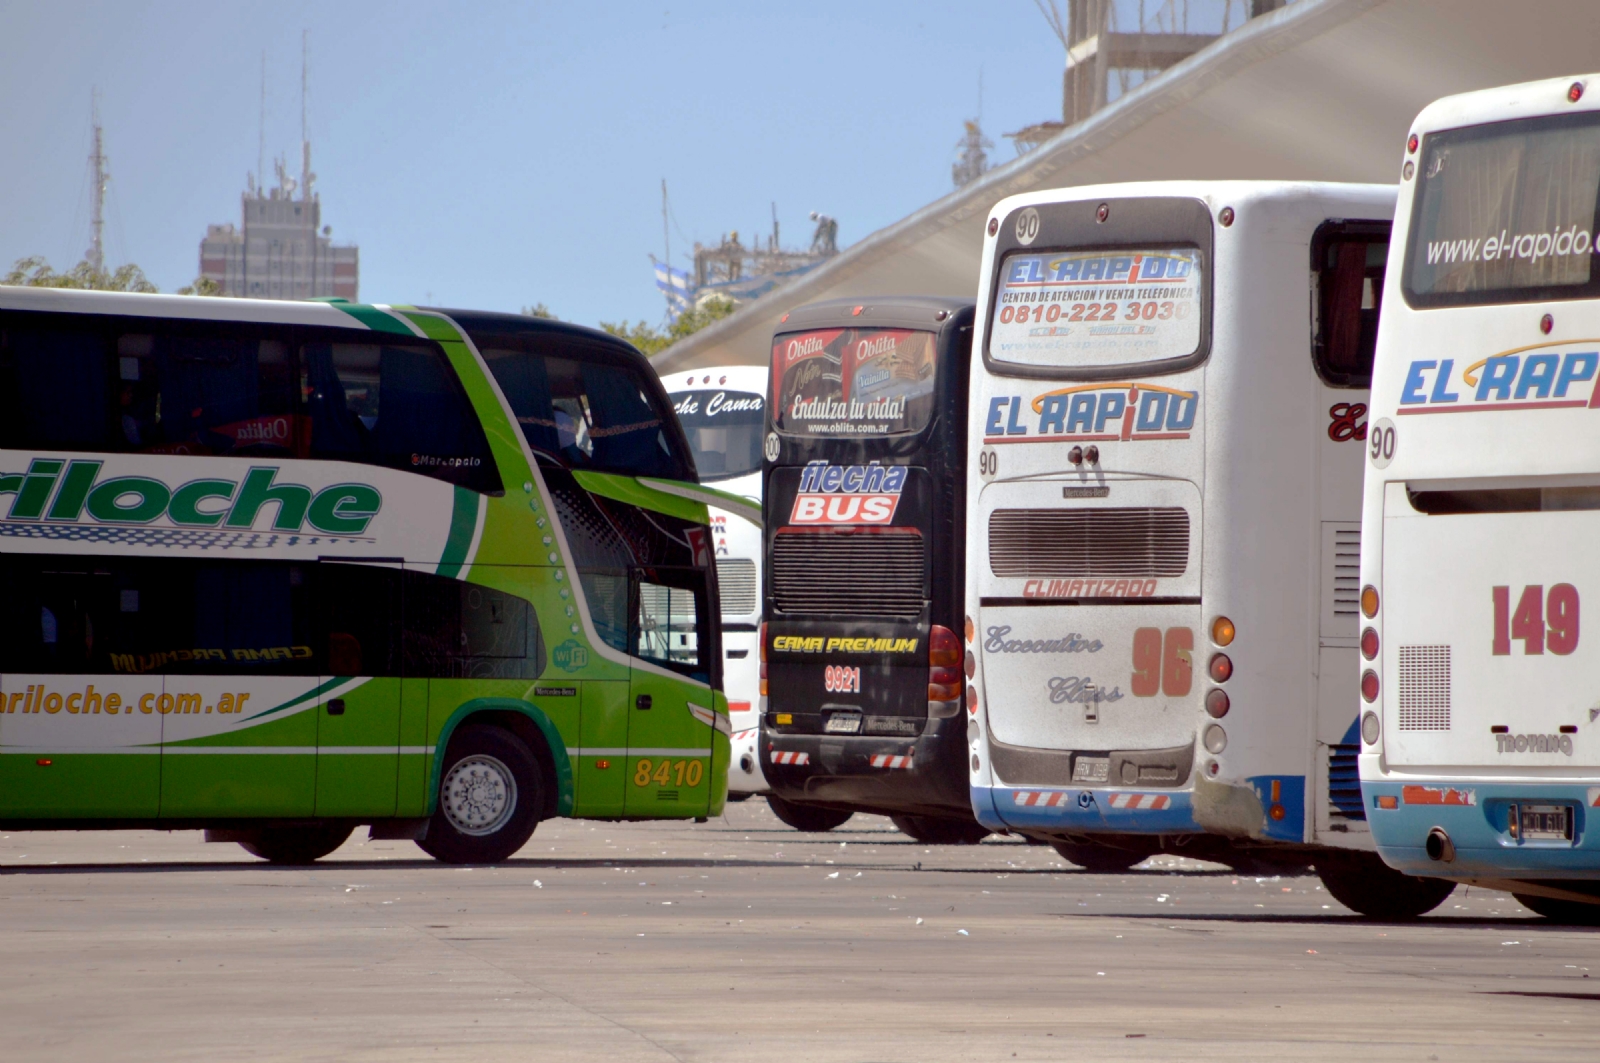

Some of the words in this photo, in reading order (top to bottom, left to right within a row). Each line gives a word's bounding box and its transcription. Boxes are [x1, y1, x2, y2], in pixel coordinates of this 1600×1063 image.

[1017, 213, 1038, 239] 90
[1007, 260, 1046, 283] EL
[1002, 291, 1036, 303] CENTRO
[1038, 291, 1050, 302] DE
[1050, 289, 1097, 302] ATENCION
[1098, 289, 1104, 300] Y
[1105, 288, 1135, 300] VENTA
[1137, 287, 1194, 299] TELEFONICA
[1000, 303, 1118, 324] 0810-222
[1125, 301, 1191, 321] 3030
[787, 336, 823, 361] Oblita
[856, 335, 896, 361] Oblita
[858, 369, 890, 388] Vainilla
[1400, 358, 1459, 405] EL
[706, 391, 763, 416] Cama
[792, 394, 847, 420] Endulza
[850, 396, 864, 420] tu
[867, 395, 906, 420] vida!
[985, 396, 1028, 435] EL
[808, 422, 889, 434] www.oblita.com.ar
[1371, 426, 1396, 460] 90
[420, 455, 481, 467] Marcopolo
[979, 451, 998, 475] 90
[798, 460, 908, 493] flecha
[1064, 487, 1110, 498] Mercedes-Benz
[801, 496, 893, 522] BUS
[1023, 579, 1157, 598] CLIMATIZADO
[1492, 583, 1580, 656] 149
[773, 635, 823, 653] CAMA
[826, 637, 918, 654] PREMIUM
[984, 625, 1104, 653] Executive
[1131, 627, 1194, 697] 96
[825, 665, 860, 693] 9921
[1047, 676, 1124, 705] Class
[536, 687, 576, 697] Mercedes-Benz
[867, 719, 915, 731] Mercedes-Benz
[1495, 734, 1573, 756] TROYANO
[634, 759, 702, 787] 8410
